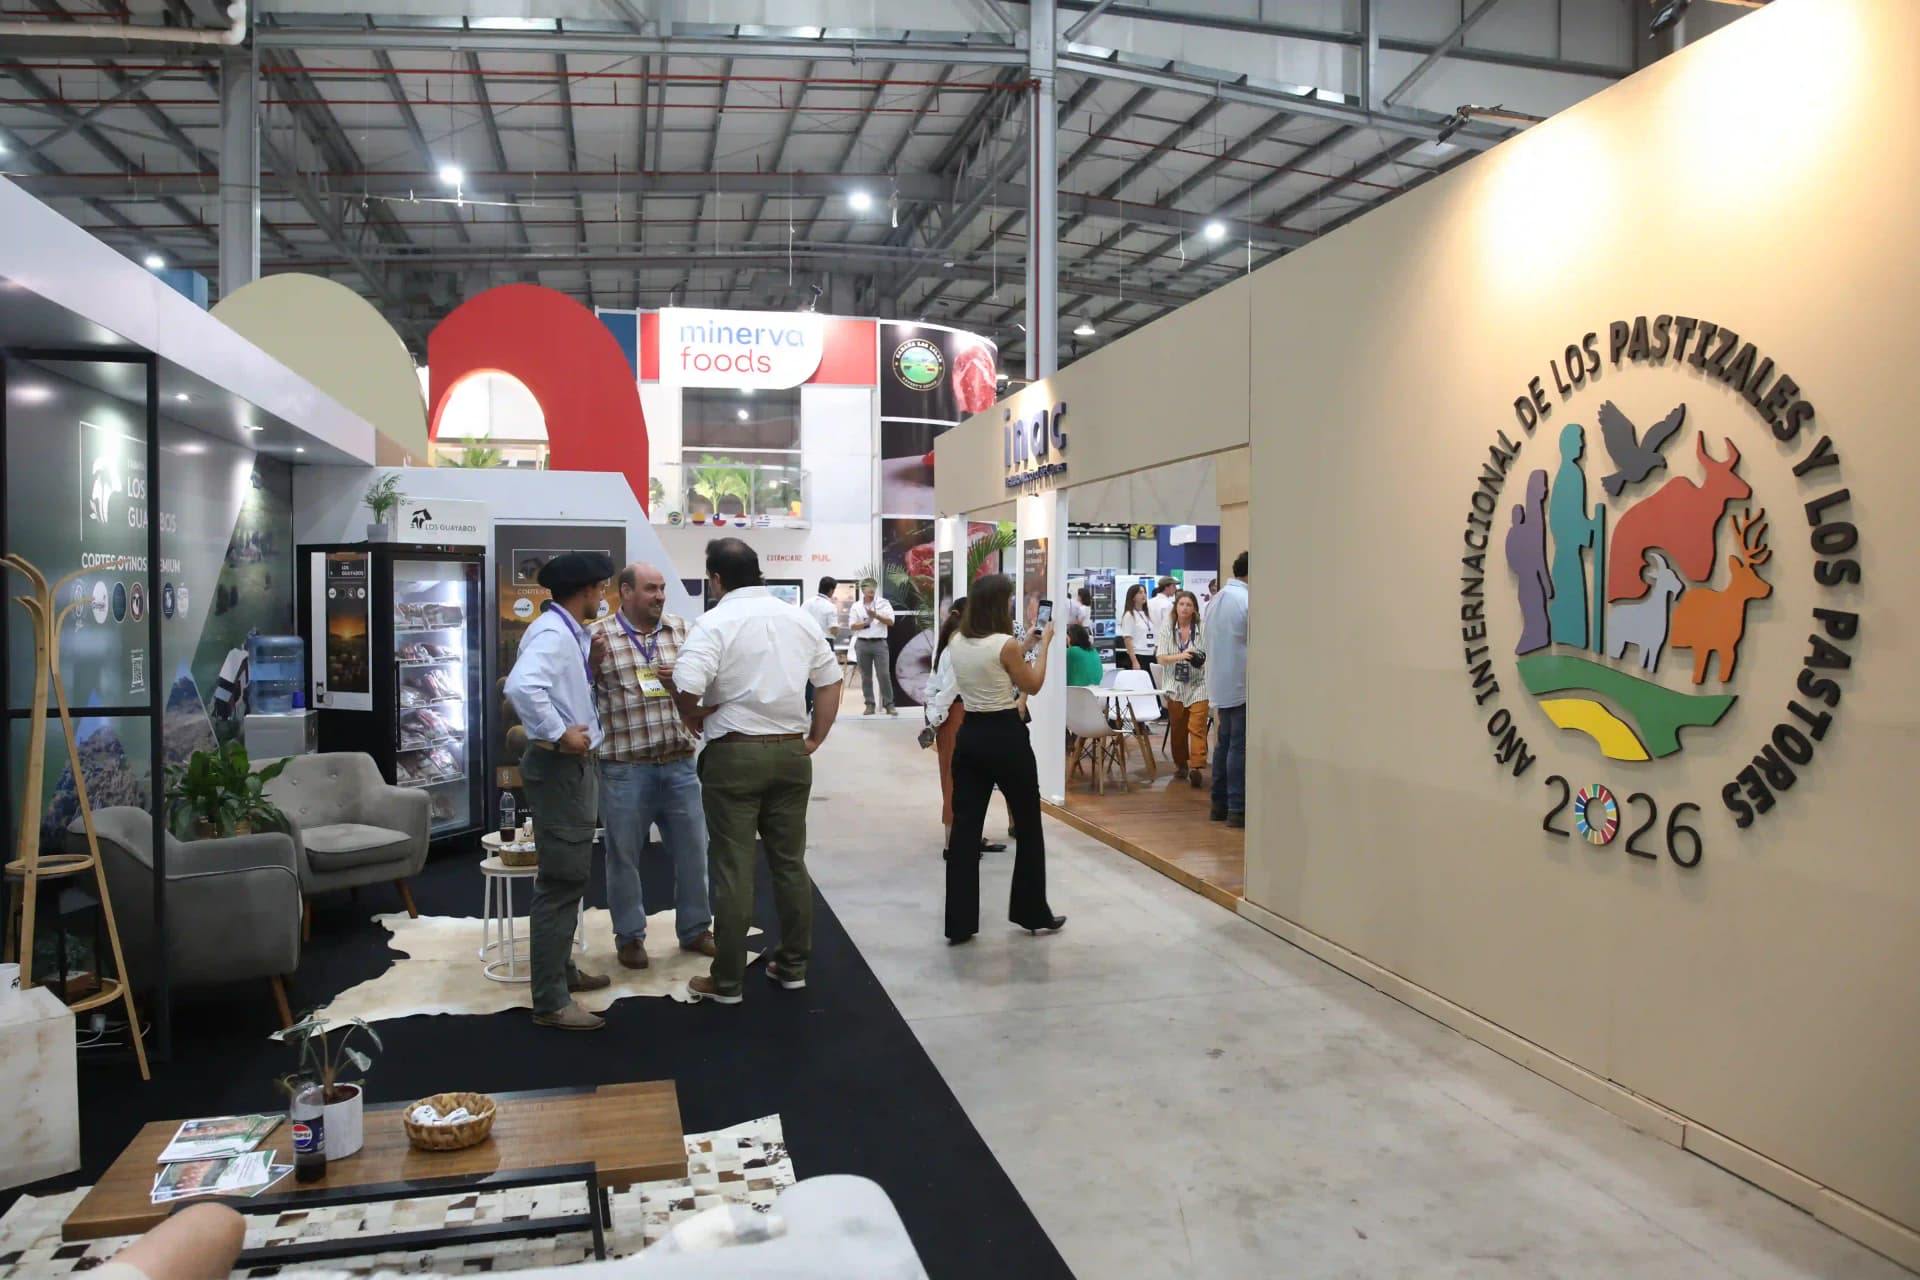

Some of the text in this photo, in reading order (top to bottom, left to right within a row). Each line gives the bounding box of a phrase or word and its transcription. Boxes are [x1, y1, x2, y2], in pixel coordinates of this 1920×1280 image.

[680, 320, 804, 346] minerva
[680, 346, 771, 373] foods
[1004, 401, 1067, 468] inac
[127, 476, 145, 499] LOS
[127, 506, 177, 533] GUABOS
[425, 523, 477, 533] LOS GUAYABOS
[1461, 314, 1861, 829] AÑO INTERNACIONAL DE LOS PASTIZALES Y LOS PASTORES
[1543, 775, 1703, 868] 2026
